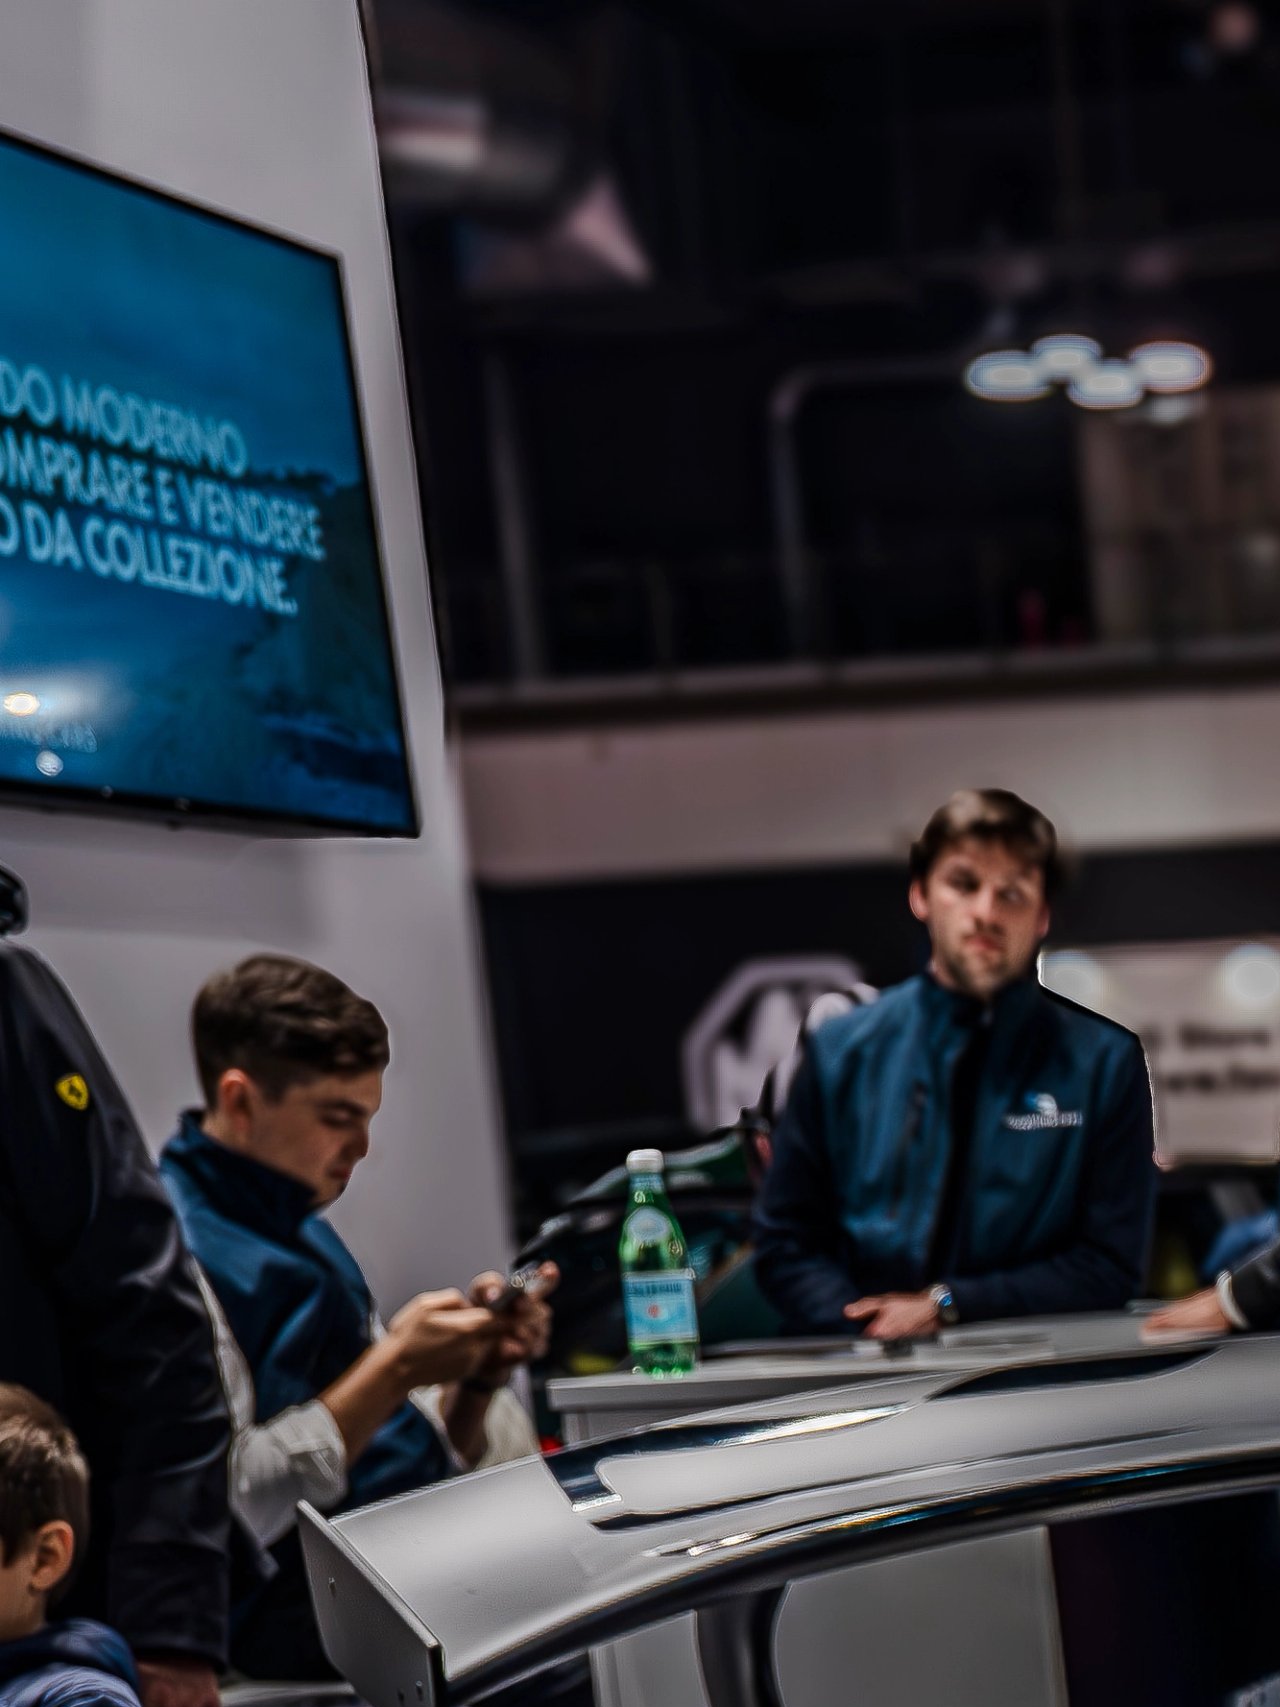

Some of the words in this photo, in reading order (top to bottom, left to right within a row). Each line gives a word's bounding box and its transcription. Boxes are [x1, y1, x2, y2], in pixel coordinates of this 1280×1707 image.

[60, 374, 249, 479] MODERNO
[0, 426, 153, 521] MPRARE
[154, 465, 181, 527] E
[176, 471, 326, 562] VENDERE
[22, 501, 84, 571] DA
